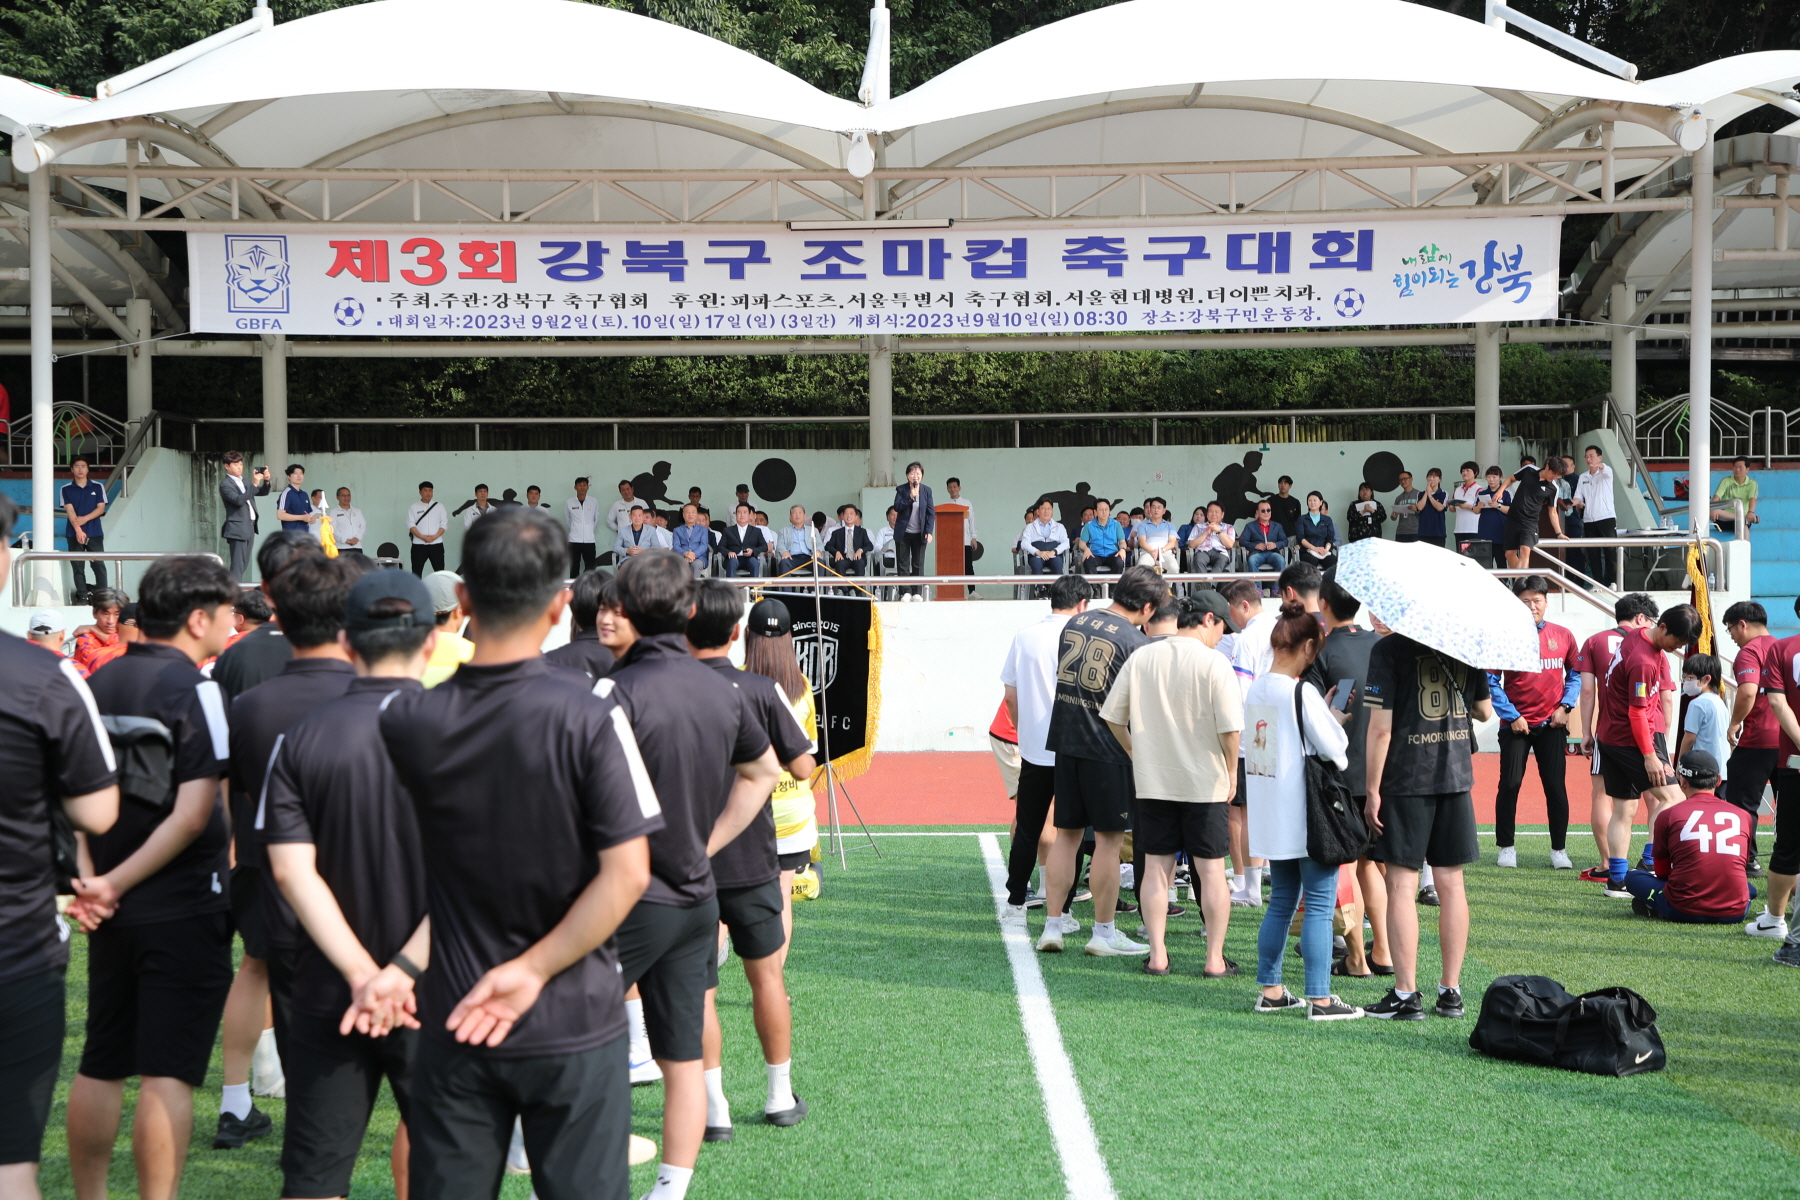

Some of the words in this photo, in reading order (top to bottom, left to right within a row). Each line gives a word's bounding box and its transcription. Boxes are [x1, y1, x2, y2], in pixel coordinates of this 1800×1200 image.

[325, 237, 517, 286] 제3회
[538, 239, 771, 282] 강북구
[801, 237, 1028, 281] 조마컵
[1062, 229, 1375, 278] 축구대회
[1459, 240, 1532, 304] 강북
[562, 292, 648, 310] 축구협회
[235, 317, 283, 330] GBFA
[792, 621, 817, 632] since
[1056, 629, 1116, 693] 28
[1408, 734, 1420, 745] FC
[1680, 810, 1741, 857] 42
